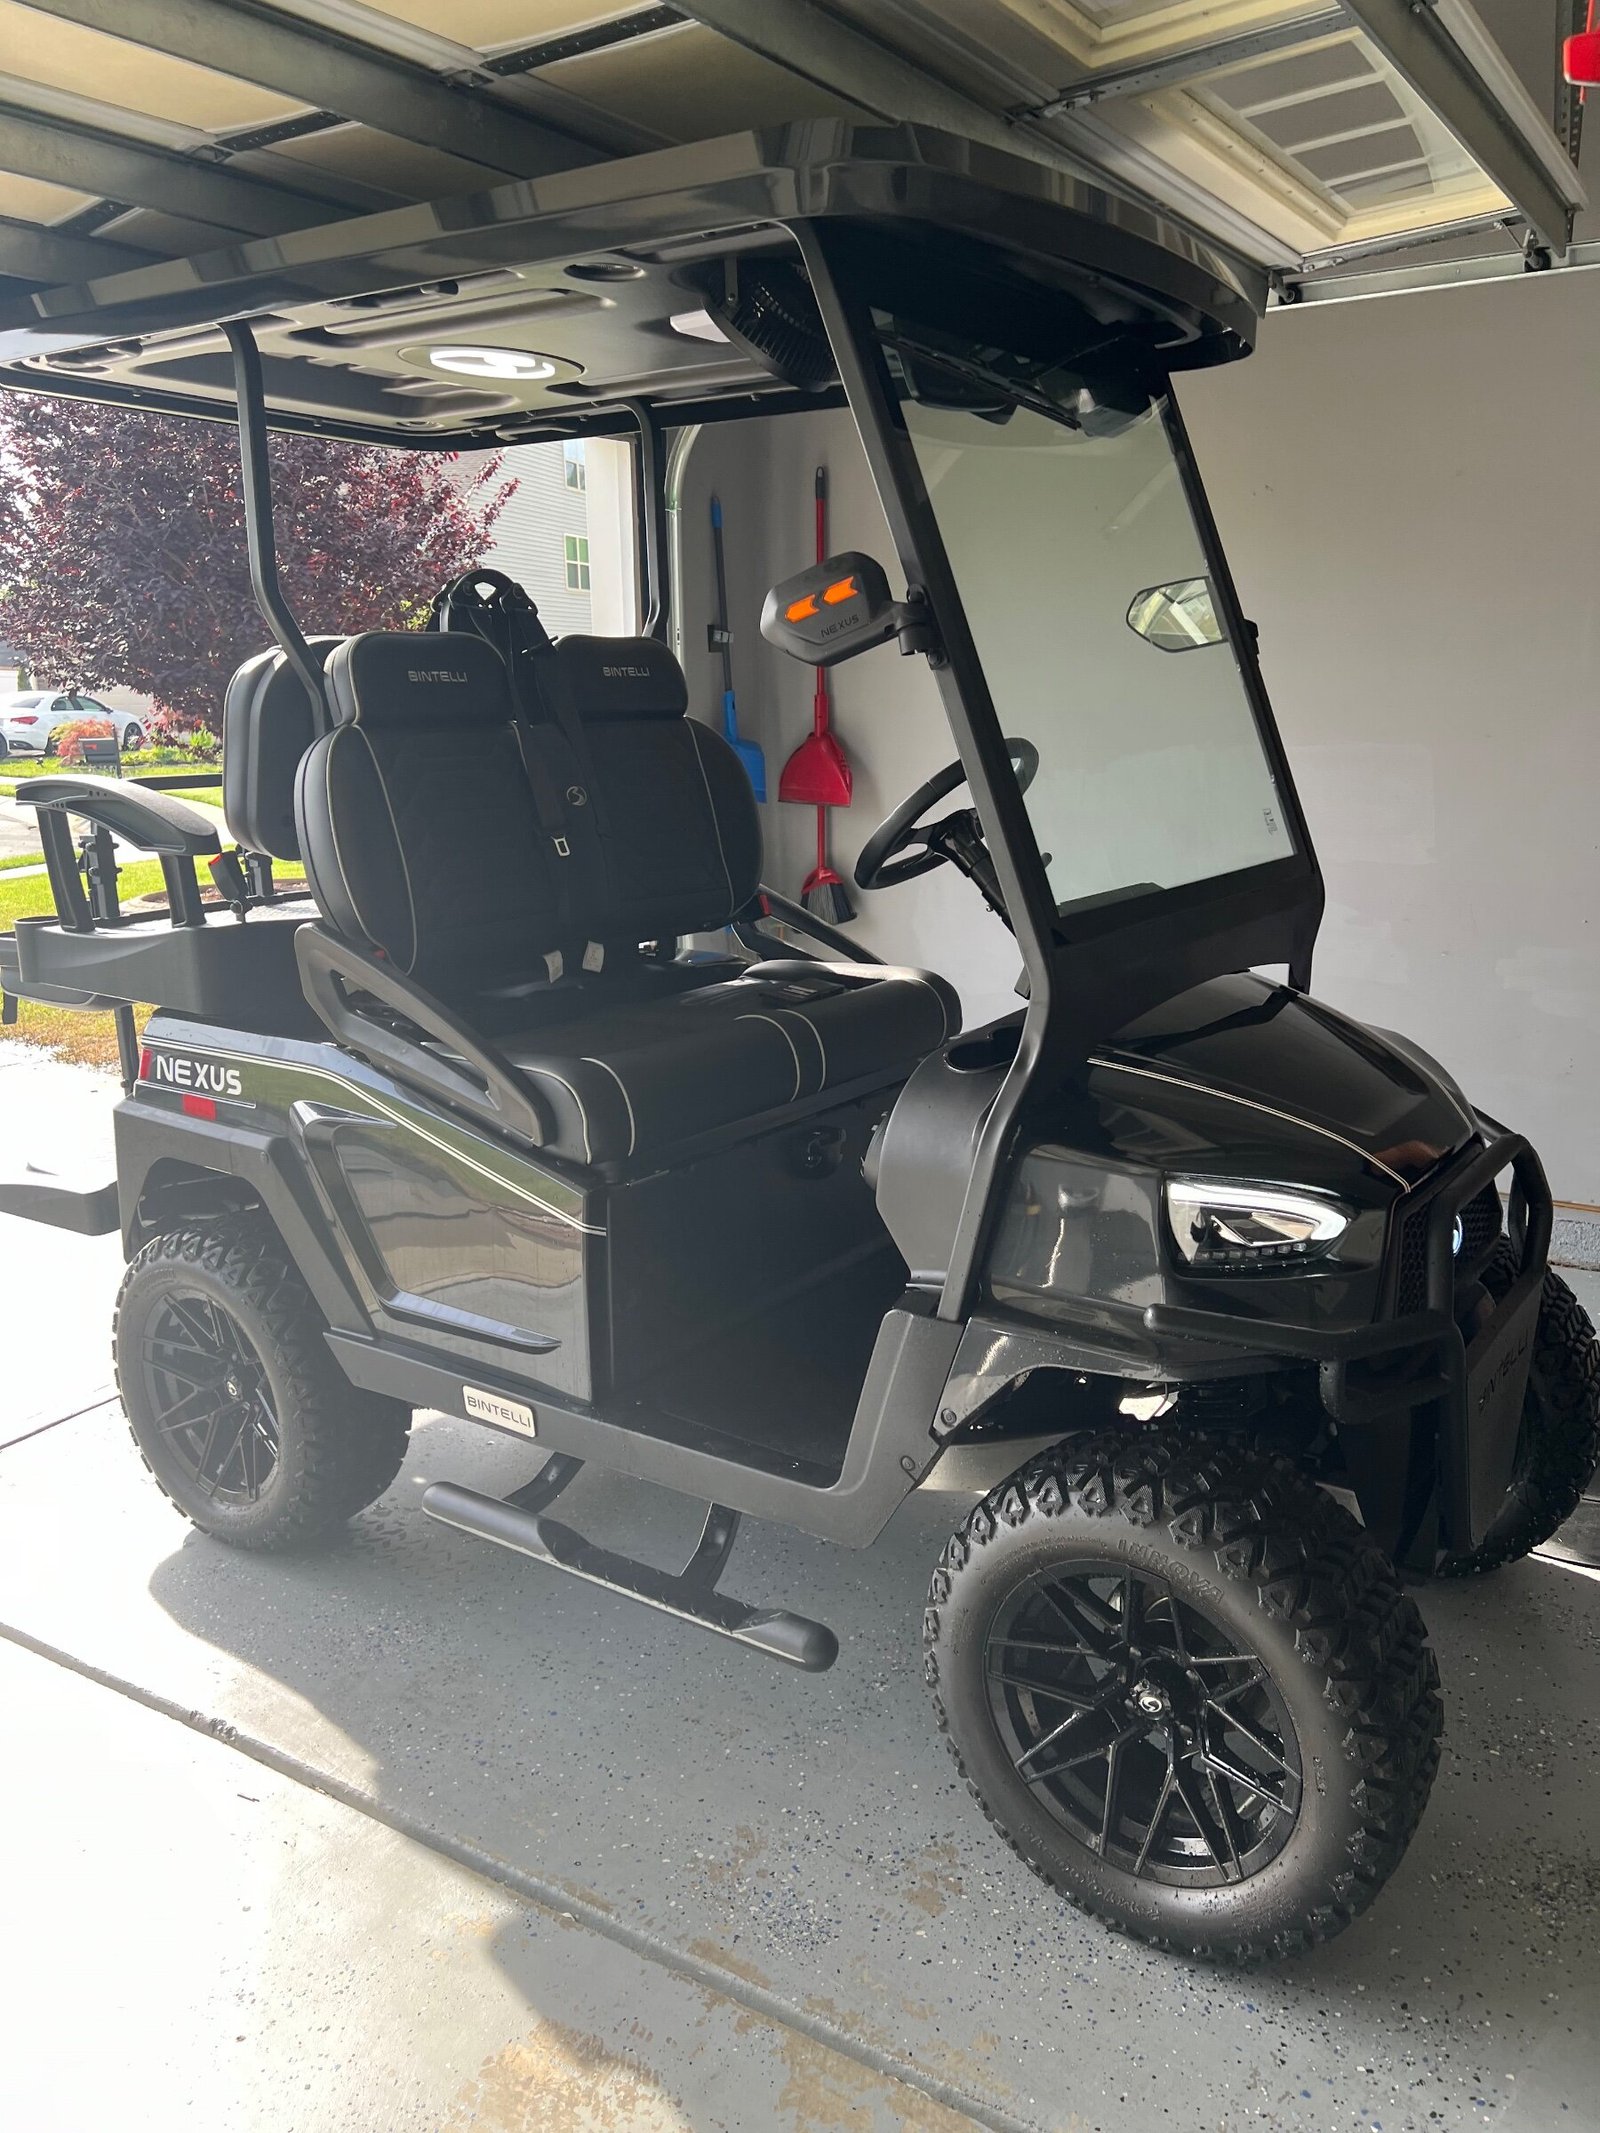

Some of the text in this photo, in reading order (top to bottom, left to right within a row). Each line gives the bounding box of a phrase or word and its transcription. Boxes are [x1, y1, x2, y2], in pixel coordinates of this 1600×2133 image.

[820, 614, 860, 637] NEXUS
[407, 670, 468, 682] BINTELLI
[601, 666, 651, 677] BINTELLI
[156, 1054, 242, 1096] NEXUS
[466, 1395, 531, 1428] BINTELLI
